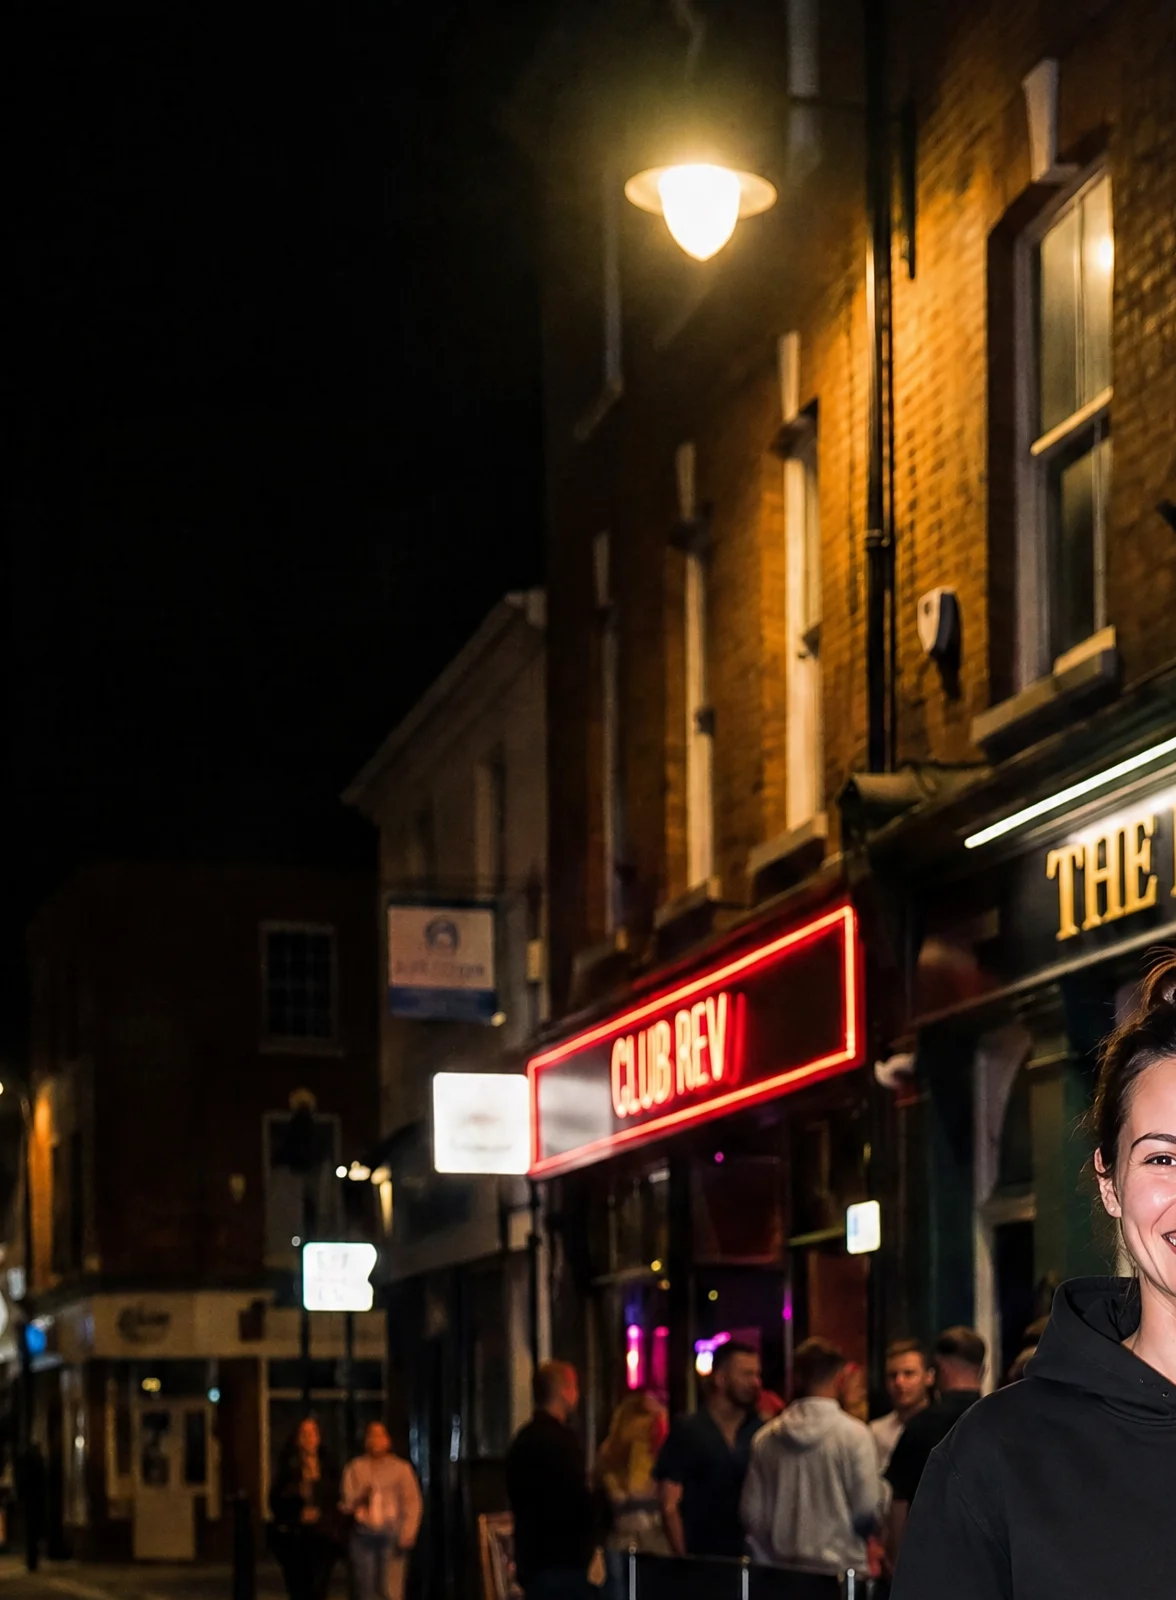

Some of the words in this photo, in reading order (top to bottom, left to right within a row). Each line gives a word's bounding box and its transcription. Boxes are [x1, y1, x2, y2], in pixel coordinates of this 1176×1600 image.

[1045, 813, 1158, 941] THE
[611, 1019, 672, 1119] CLUB
[674, 991, 728, 1096] REV
